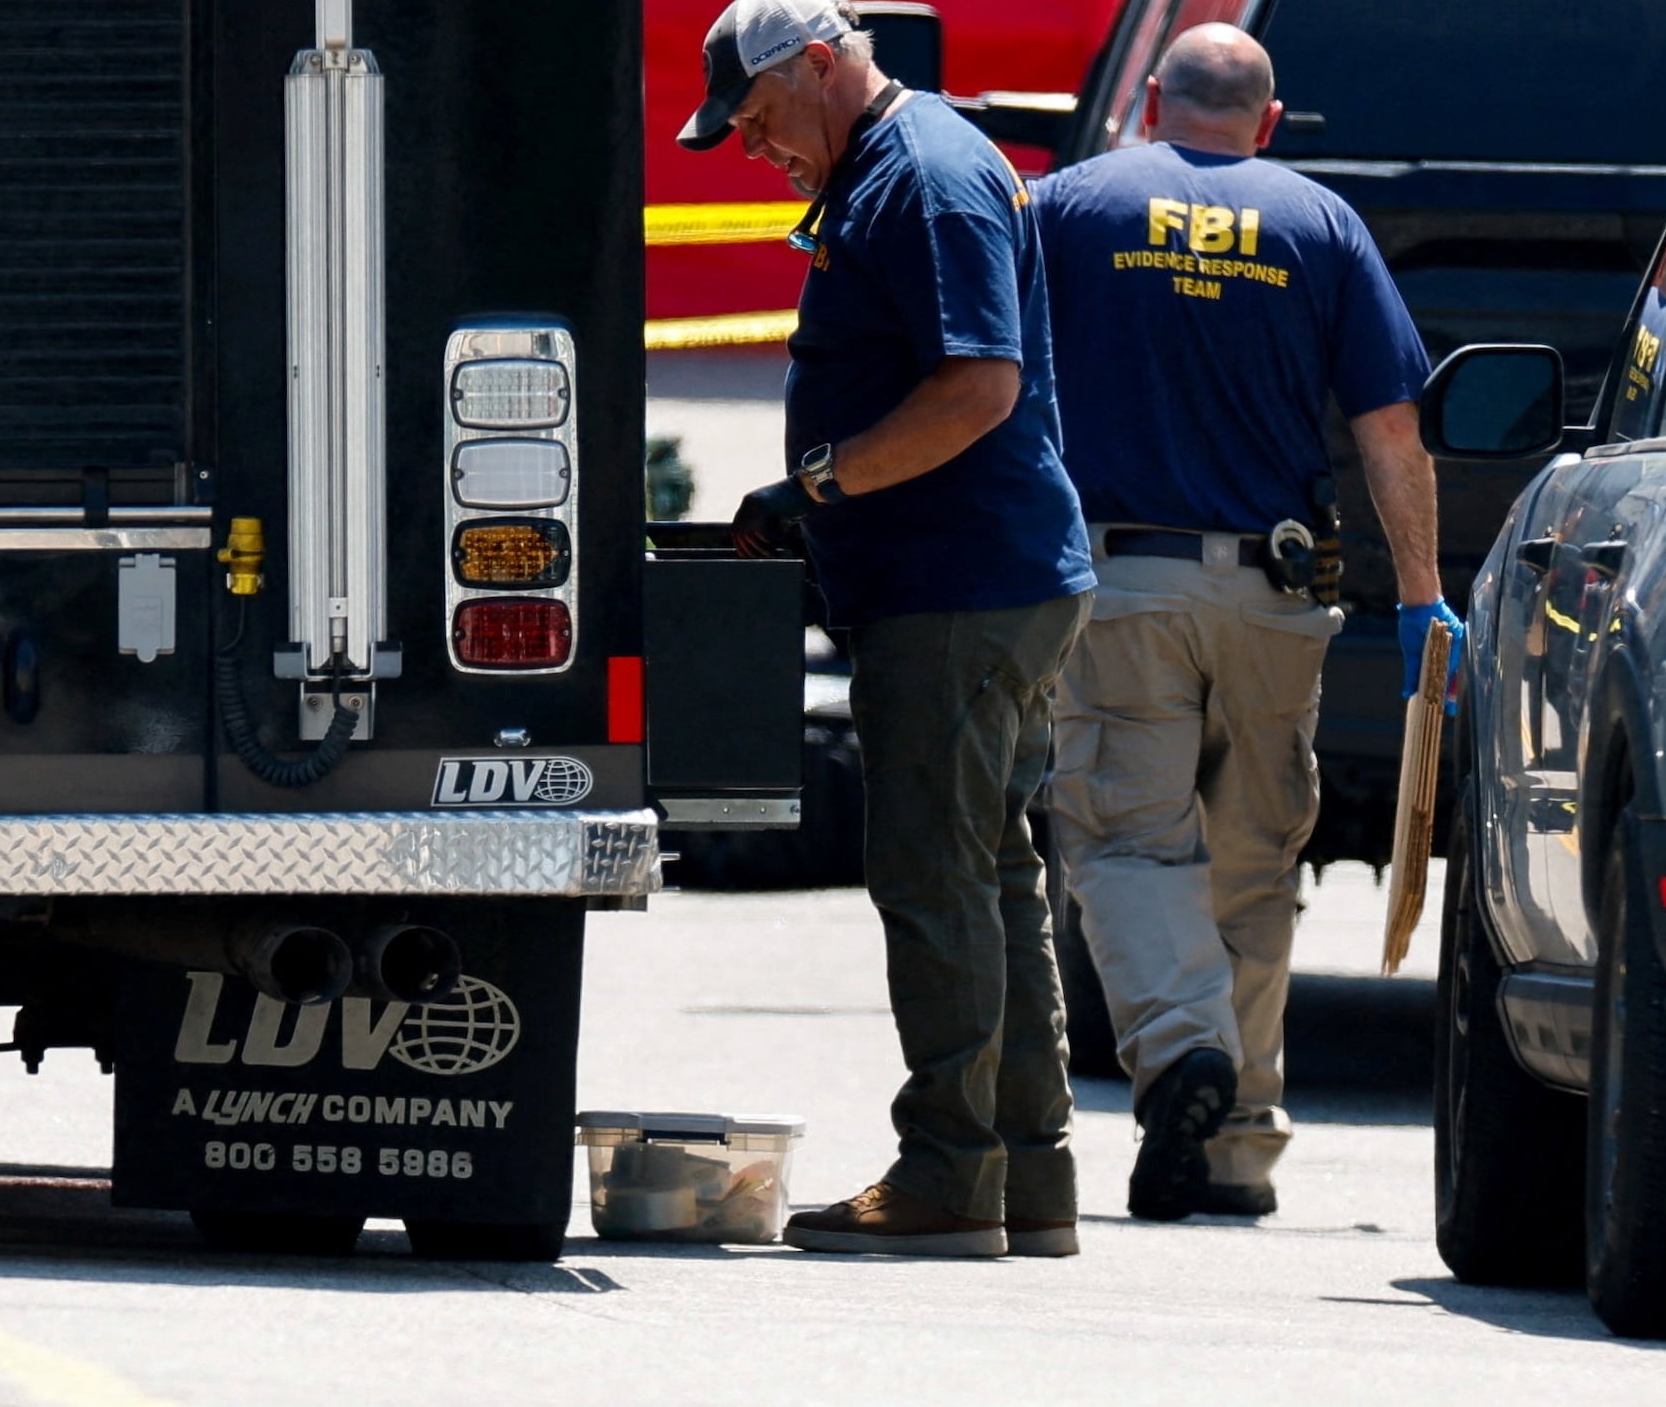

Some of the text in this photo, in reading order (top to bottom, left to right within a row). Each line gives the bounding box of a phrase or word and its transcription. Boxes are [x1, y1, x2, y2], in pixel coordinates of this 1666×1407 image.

[1147, 196, 1261, 257] FBI
[1113, 250, 1289, 288] EVIDENCE RESPONSE
[1172, 276, 1223, 300] TEAM
[438, 760, 547, 803] LDV
[173, 971, 411, 1071] LDV
[171, 1088, 515, 1129] A LYNCH COMPANY
[203, 1141, 474, 1180] 800 558 5986
